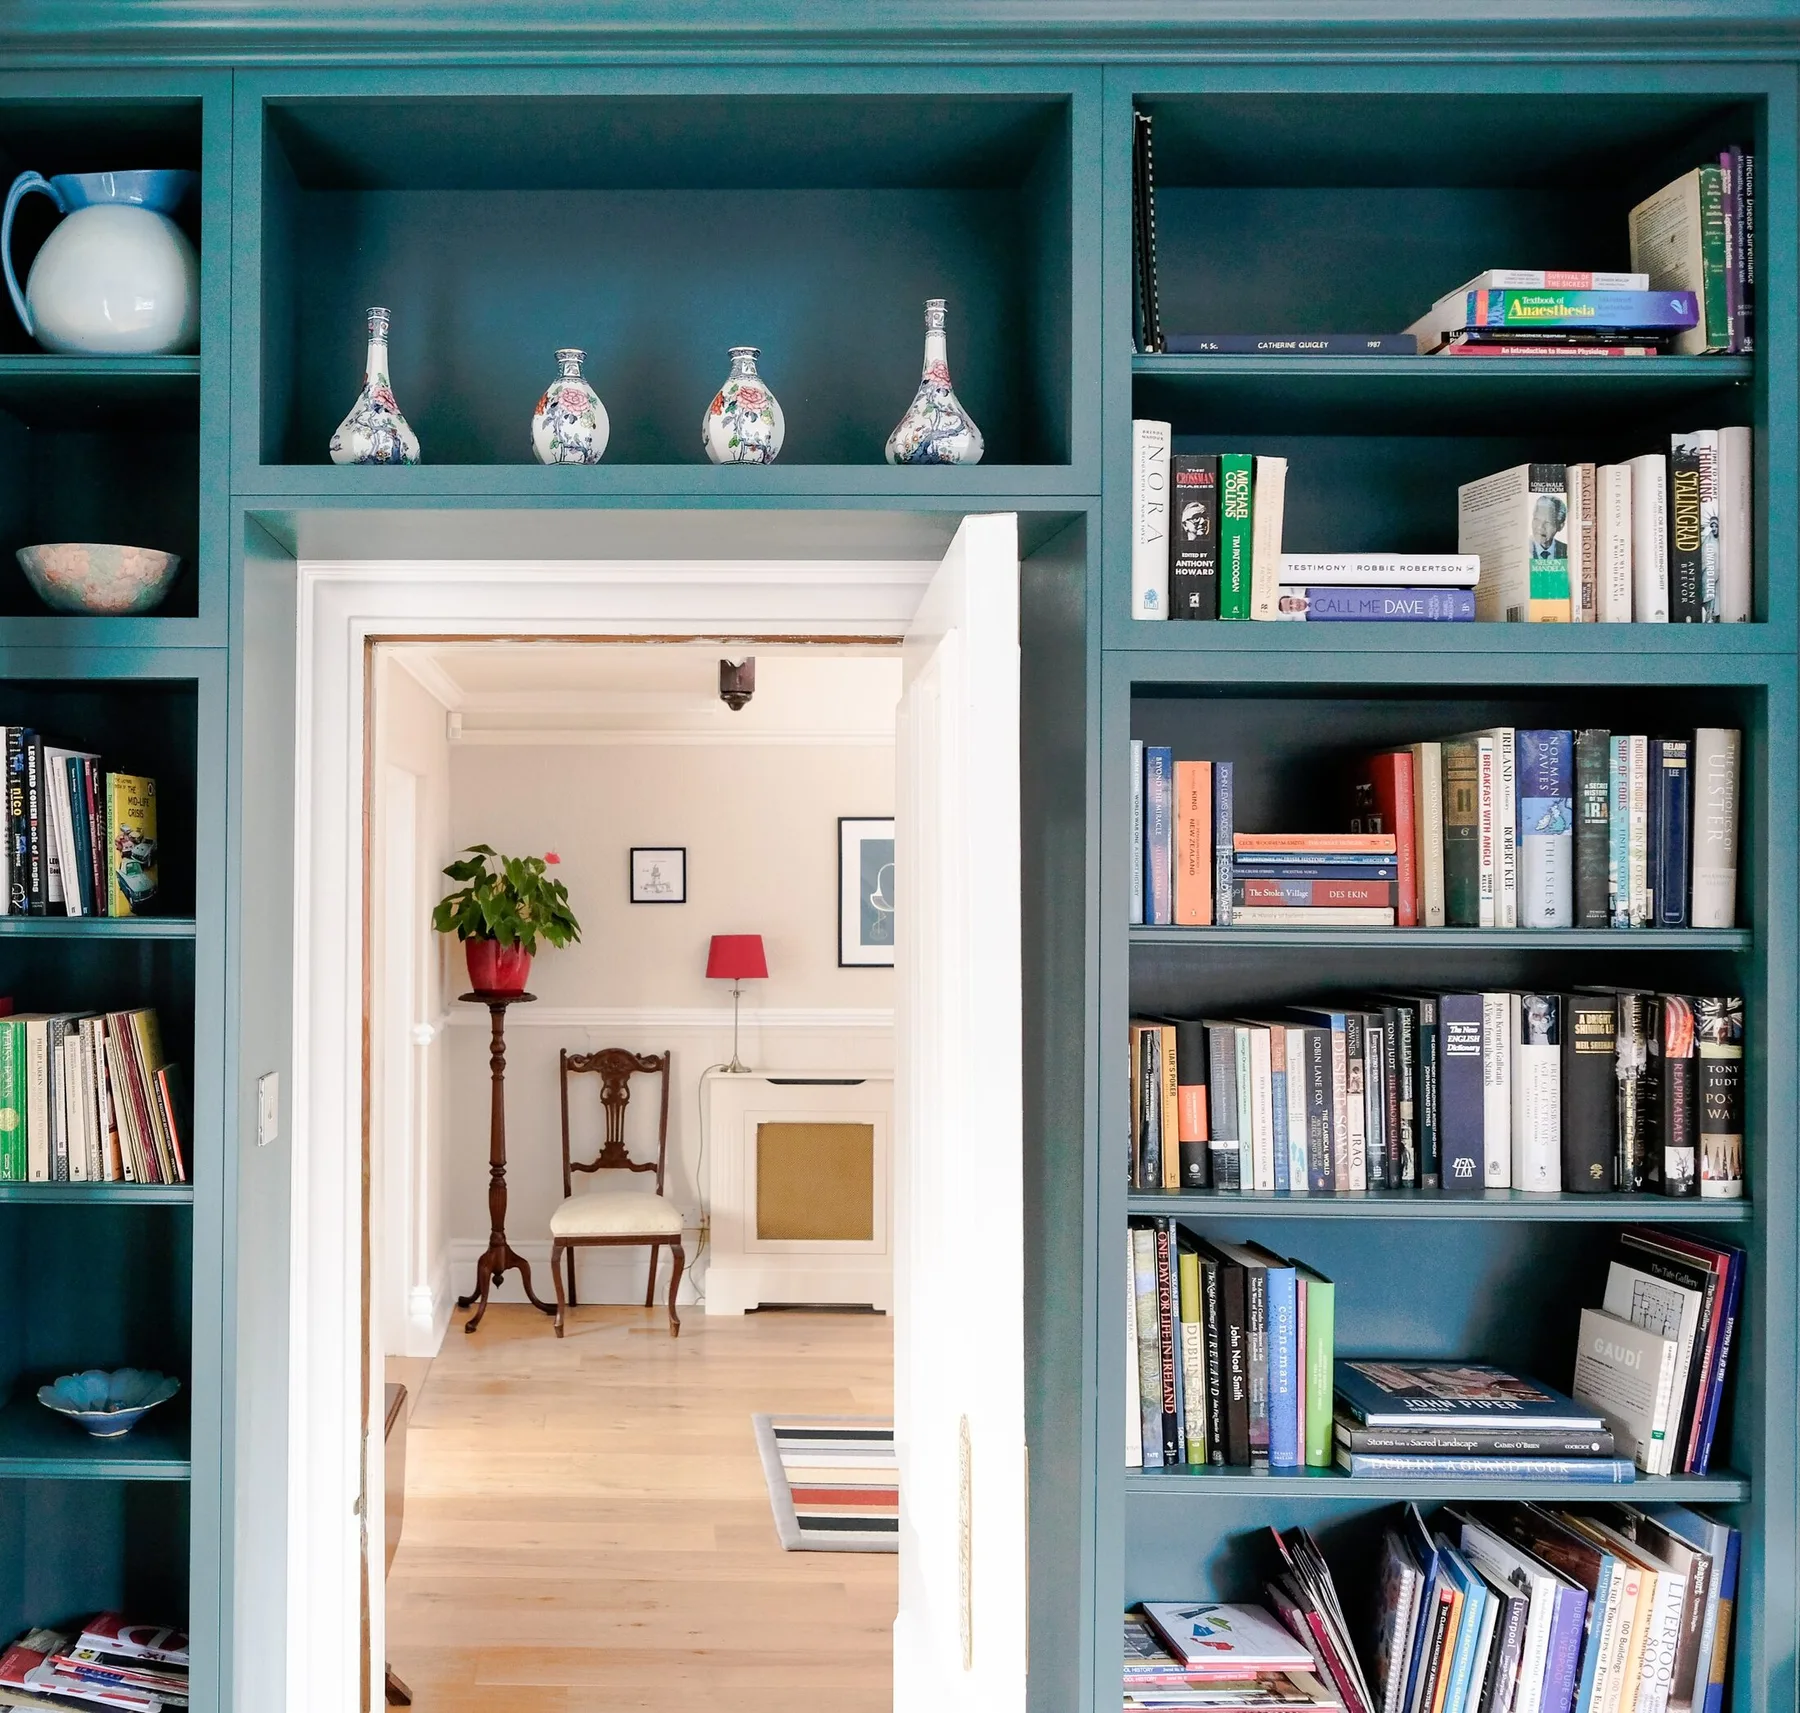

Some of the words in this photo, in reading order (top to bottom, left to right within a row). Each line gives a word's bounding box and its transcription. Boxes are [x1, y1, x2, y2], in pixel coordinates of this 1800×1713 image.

[1508, 299, 1595, 318] Anaesthesia
[1522, 296, 1555, 304] Textbook
[1556, 296, 1564, 305] of
[1299, 341, 1329, 349] QUIGLEY
[1176, 472, 1215, 485] CROSSMAN
[1700, 445, 1713, 503] THINKING
[1147, 445, 1164, 543] NORA
[1225, 472, 1237, 517] COLLINS
[1236, 469, 1248, 520] MICHAEL
[1675, 471, 1699, 552] STALINGRAD
[1314, 599, 1356, 613] CALL
[1359, 599, 1381, 613] ME
[1384, 600, 1424, 614] DAVE
[1618, 739, 1627, 762] SHIP
[28, 745, 36, 787] LEONARD
[1539, 743, 1549, 790] DAVIES
[1550, 736, 1560, 796] NORMAN
[1618, 766, 1627, 777] OF
[1483, 754, 1491, 807] BREAKFAST
[12, 788, 23, 816] nico
[29, 789, 37, 819] COHEN
[128, 797, 150, 807] MID-LIFE
[1618, 781, 1627, 811] FOOLS
[1707, 754, 1725, 844] ULSTER
[128, 809, 144, 818] CRISIS
[1483, 810, 1491, 833] WITH
[1584, 802, 1608, 817] IRA
[29, 820, 38, 842] Book
[30, 845, 38, 856] of
[1221, 849, 1229, 864] THE
[1483, 836, 1492, 866] ANGLO
[1503, 826, 1513, 867] ROBERT
[1545, 840, 1555, 867] THE
[30, 858, 39, 894] Longing
[1221, 868, 1229, 891] COLD
[1504, 869, 1514, 890] KEE
[1545, 871, 1555, 904] ISLES
[1221, 893, 1229, 912] WAR
[1286, 889, 1309, 898] Village
[1329, 890, 1344, 898] DES
[1347, 890, 1368, 898] EKIN
[1313, 1036, 1322, 1062] ROBIN
[1388, 1047, 1396, 1070] JUDT
[2, 1065, 13, 1097] POEMS
[1314, 1065, 1322, 1087] LANE
[1707, 1065, 1738, 1073] TONY
[1709, 1078, 1737, 1086] JUDT
[1314, 1089, 1323, 1105] FOX
[1673, 1063, 1683, 1142] REAPPRAISALS
[1350, 1133, 1363, 1169] IRAQ
[1158, 1231, 1168, 1258] ONE
[1159, 1261, 1169, 1285] DAY
[1651, 1263, 1661, 1274] The
[1662, 1267, 1674, 1278] Tate
[1675, 1271, 1698, 1288] Gallery
[1160, 1287, 1170, 1310] FOR
[1161, 1312, 1171, 1337] LIFE
[1230, 1325, 1240, 1347] John
[1162, 1340, 1171, 1354] IN
[1186, 1325, 1198, 1378] DUBLIN
[1279, 1306, 1288, 1393] connemara
[1594, 1337, 1643, 1370] GAUDÍ
[1721, 1347, 1730, 1359] THE
[1232, 1350, 1241, 1373] Noel
[1719, 1360, 1727, 1369] OF
[1162, 1357, 1174, 1413] IRELAND
[1232, 1375, 1242, 1400] Smith
[1405, 1399, 1457, 1408] JOHN
[1461, 1400, 1524, 1410] PIPER
[1599, 1564, 1613, 1603] Liverpool
[1441, 1605, 1449, 1616] THE
[1570, 1600, 1582, 1636] PUBLIC
[1436, 1616, 1447, 1640] CLASSICAL
[1507, 1601, 1523, 1648] Liverpool
[1654, 1582, 1684, 1695] LIVERPOOL
[1431, 1640, 1442, 1666] LANGUAGE
[1641, 1638, 1659, 1679] 800
[1561, 1639, 1578, 1693] SCULPTURE
[1424, 1672, 1436, 1708] ARCHITECTURE
[1560, 1697, 1570, 1711] OF
